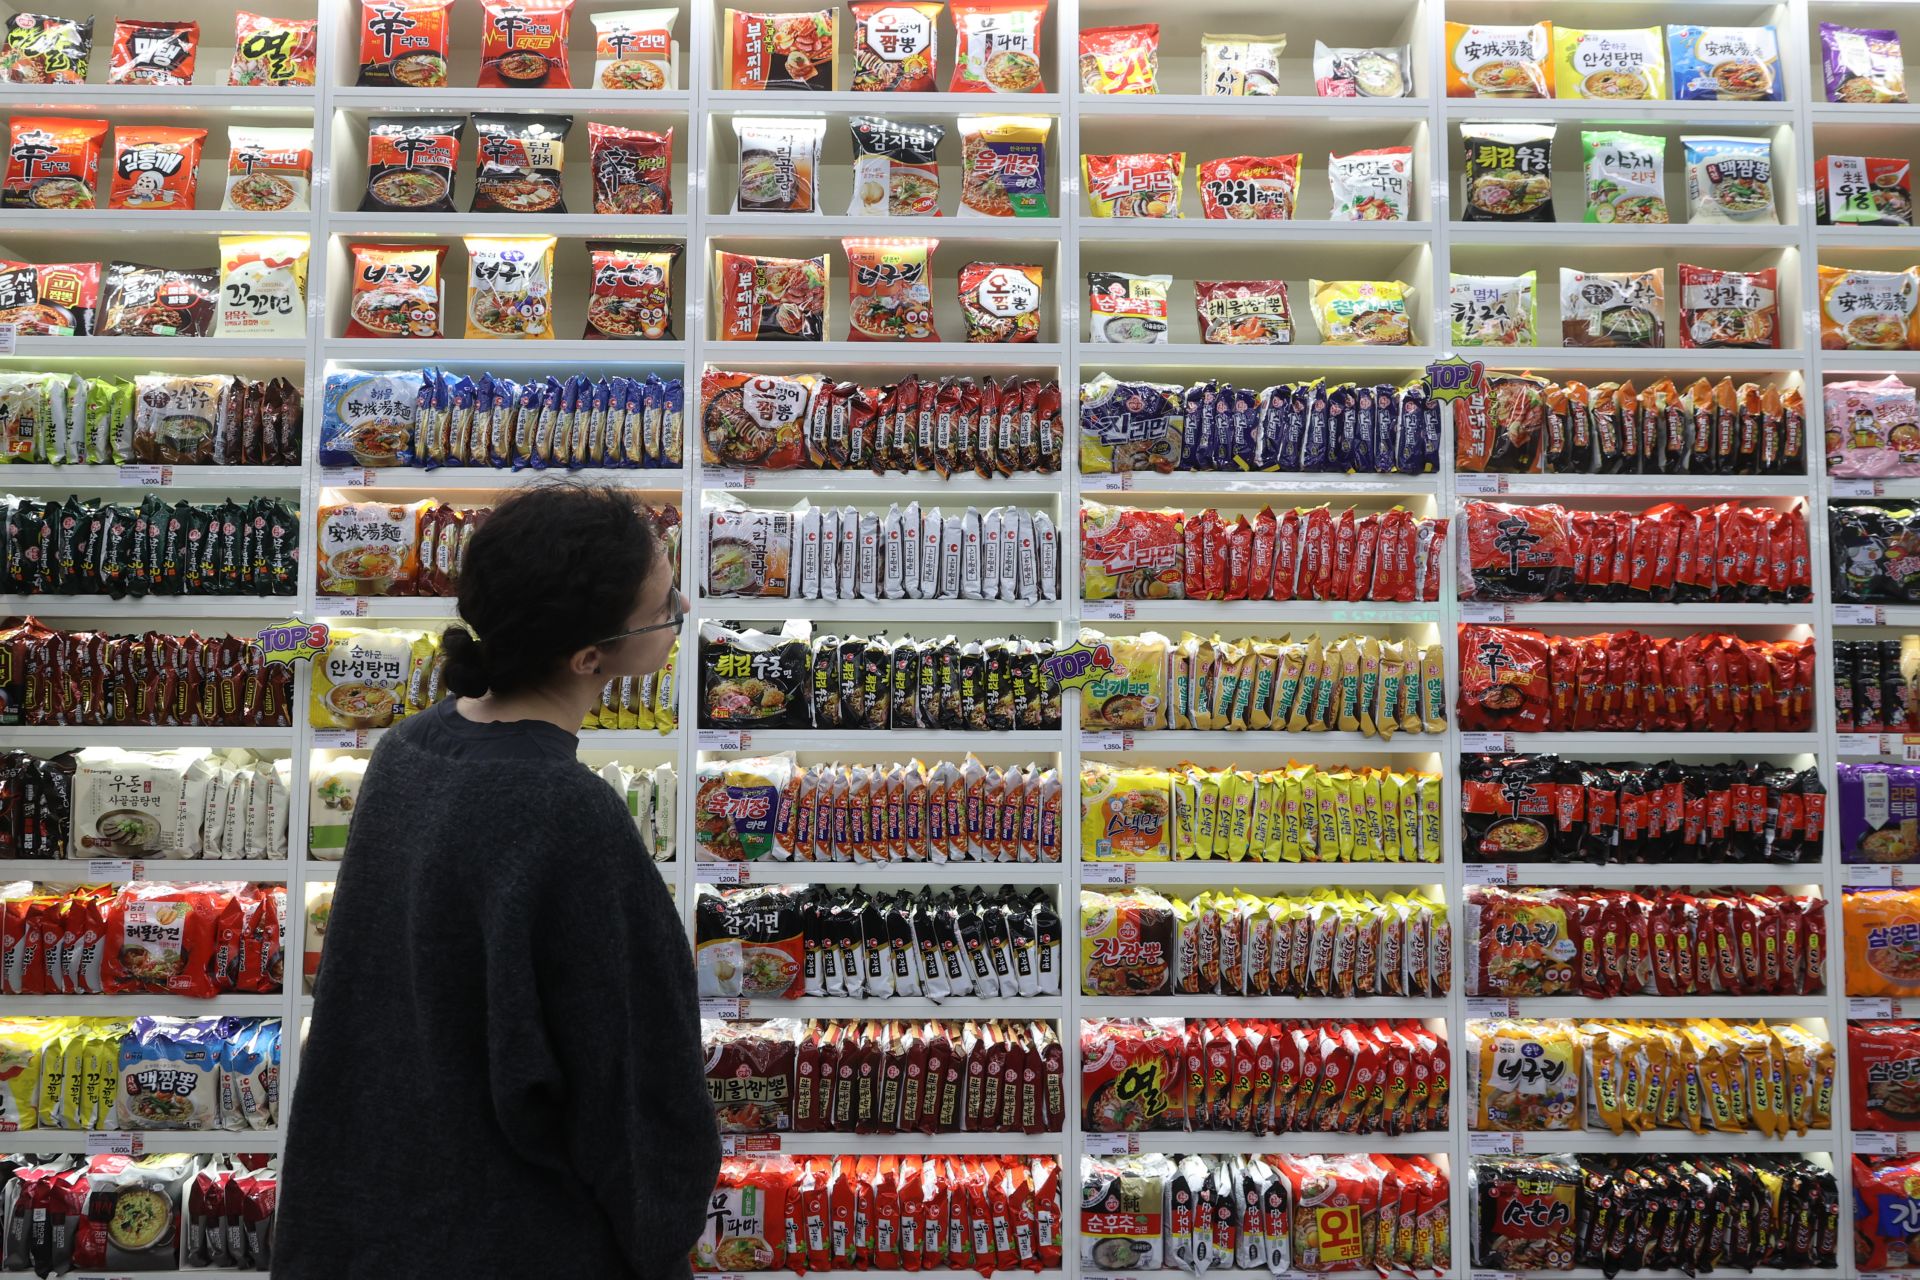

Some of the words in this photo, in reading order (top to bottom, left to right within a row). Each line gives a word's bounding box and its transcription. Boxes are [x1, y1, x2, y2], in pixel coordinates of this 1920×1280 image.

[369, 1, 416, 57] 辛
[494, 6, 532, 48] 辛
[527, 23, 551, 34] 라면
[876, 14, 921, 34] 오징어
[401, 35, 430, 47] 라면
[516, 35, 553, 49] 더레드
[607, 25, 637, 59] 辛
[639, 34, 666, 48] 건면
[745, 22, 761, 81] 부대찌개
[879, 34, 916, 54] 짬뽕
[996, 34, 1027, 51] 파마
[242, 30, 298, 80] 열
[1582, 51, 1644, 68] 안성탕면
[483, 133, 515, 168] 辛
[527, 141, 551, 153] 두부
[869, 133, 926, 152] 감자면
[12, 130, 58, 182] 辛
[40, 160, 71, 173] 라면
[269, 152, 299, 166] 건면
[416, 155, 452, 166] BLACK
[531, 153, 554, 167] 김치
[973, 149, 1039, 177] 육개장
[1476, 145, 1550, 171] 튀김우동
[1604, 150, 1655, 172] 야채
[1719, 158, 1771, 184] 백짬뽕
[1842, 170, 1865, 185] 生生
[1014, 177, 1038, 189] 라면
[1099, 168, 1172, 203] 진라면
[1206, 181, 1256, 206] 김치
[1256, 186, 1285, 205] 라면
[1371, 176, 1404, 195] 라면
[1835, 184, 1871, 211] 우동
[50, 277, 76, 291] 고기
[225, 282, 294, 316] 꼬꼬면
[989, 296, 1030, 311] 짬뽕
[1472, 287, 1500, 303] 멸치
[1208, 297, 1283, 318] 해물짬뽕
[1426, 361, 1485, 389] TOP.1
[370, 388, 395, 400] 해물
[347, 399, 412, 419] 安城湯麵
[1098, 412, 1171, 447] 진라면
[1468, 393, 1486, 457] 부대찌개
[328, 522, 402, 543] 安城湯麵
[1494, 515, 1542, 577] 辛
[1102, 541, 1179, 577] 진라면
[1525, 551, 1555, 564] 라면
[258, 623, 328, 654] TOP.3
[330, 659, 401, 680] 안성탕면
[714, 653, 783, 680] 튀김우동
[1046, 645, 1114, 682] TOP.4
[1477, 641, 1512, 683] 辛
[1090, 678, 1150, 698] 참깨라면
[108, 774, 142, 794] 우돈
[108, 795, 161, 808] 사골곰탕면
[707, 791, 770, 819] 육개장
[1501, 772, 1538, 821] 辛
[1521, 804, 1550, 813] BLACK
[745, 819, 768, 831] 라면
[1107, 813, 1160, 837] 스낵면
[126, 924, 181, 943] 해물탕면
[722, 911, 781, 935] 감자면
[1495, 921, 1559, 948] 너구리
[1091, 937, 1164, 966] 진짬뽕
[138, 1070, 198, 1094] 백짬뽕
[1497, 1058, 1568, 1085] 너구리
[1122, 1194, 1141, 1213] 純
[726, 1217, 759, 1237] 파마
[1087, 1213, 1135, 1234] 순후추
[1320, 1207, 1361, 1249] 오!
[1340, 1244, 1361, 1258] 라면
